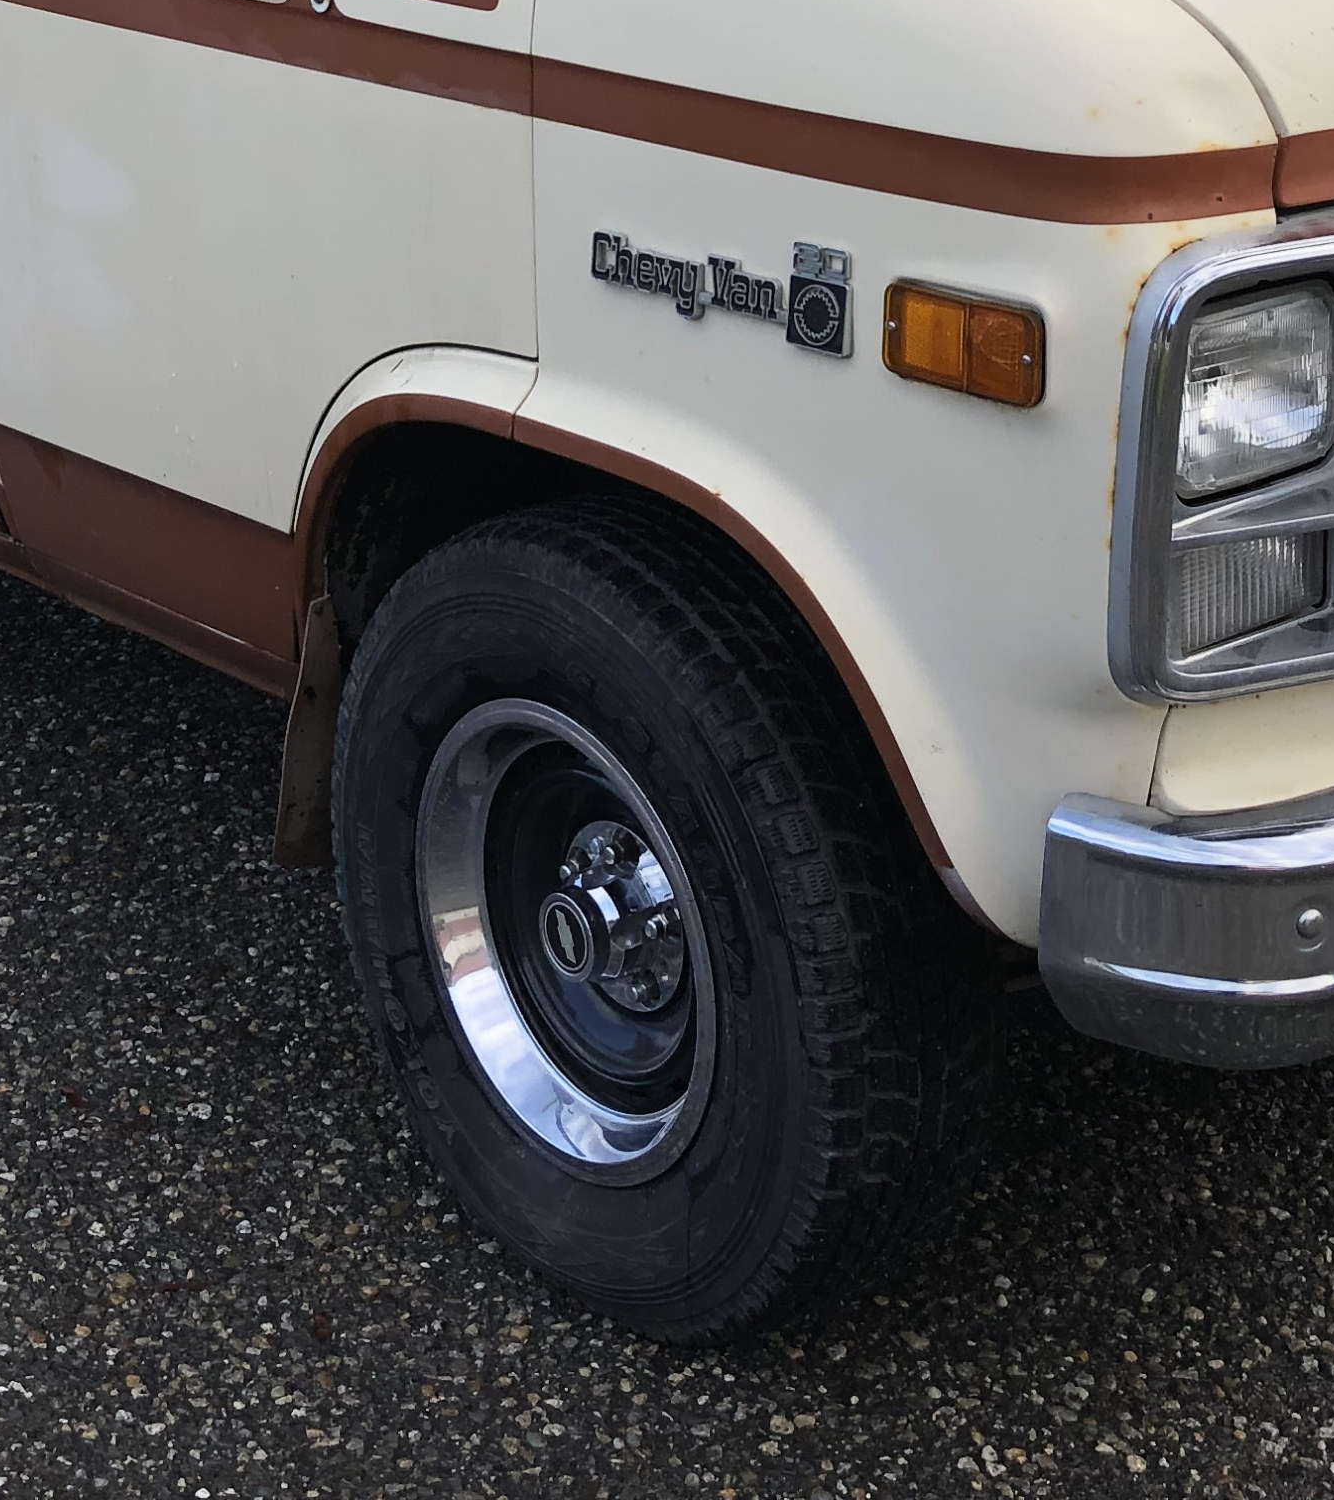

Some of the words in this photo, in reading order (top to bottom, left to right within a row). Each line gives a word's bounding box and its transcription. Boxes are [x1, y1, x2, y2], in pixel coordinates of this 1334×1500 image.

[591, 230, 705, 320] Chevy
[707, 254, 785, 320] Van
[793, 241, 851, 283] 20
